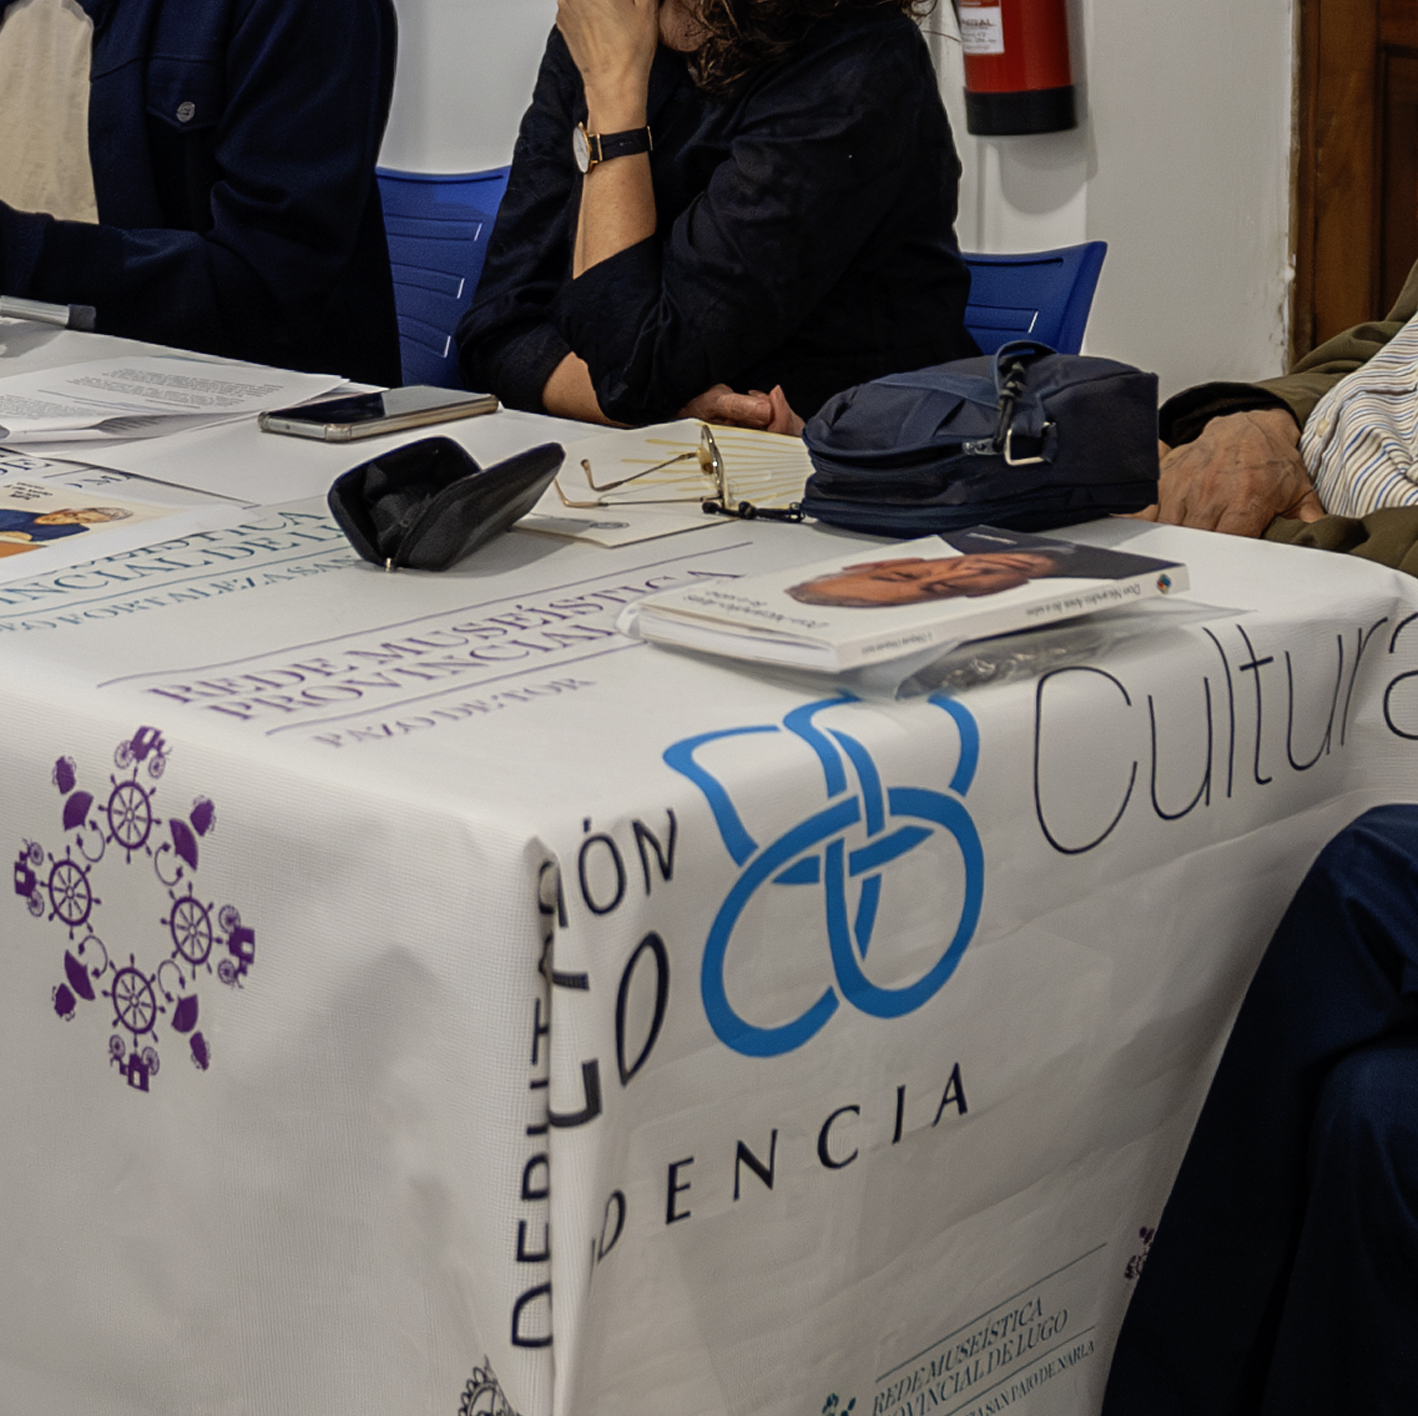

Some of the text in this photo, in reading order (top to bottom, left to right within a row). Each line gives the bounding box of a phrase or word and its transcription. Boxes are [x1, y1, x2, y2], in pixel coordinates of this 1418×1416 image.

[199, 536, 301, 561] DE
[147, 658, 358, 703] REDE
[312, 678, 597, 748] PAZO DE TOR
[893, 1308, 1069, 1416] OVINCIAL DE LUGO
[925, 1295, 1044, 1385] MUSEÍSTICA
